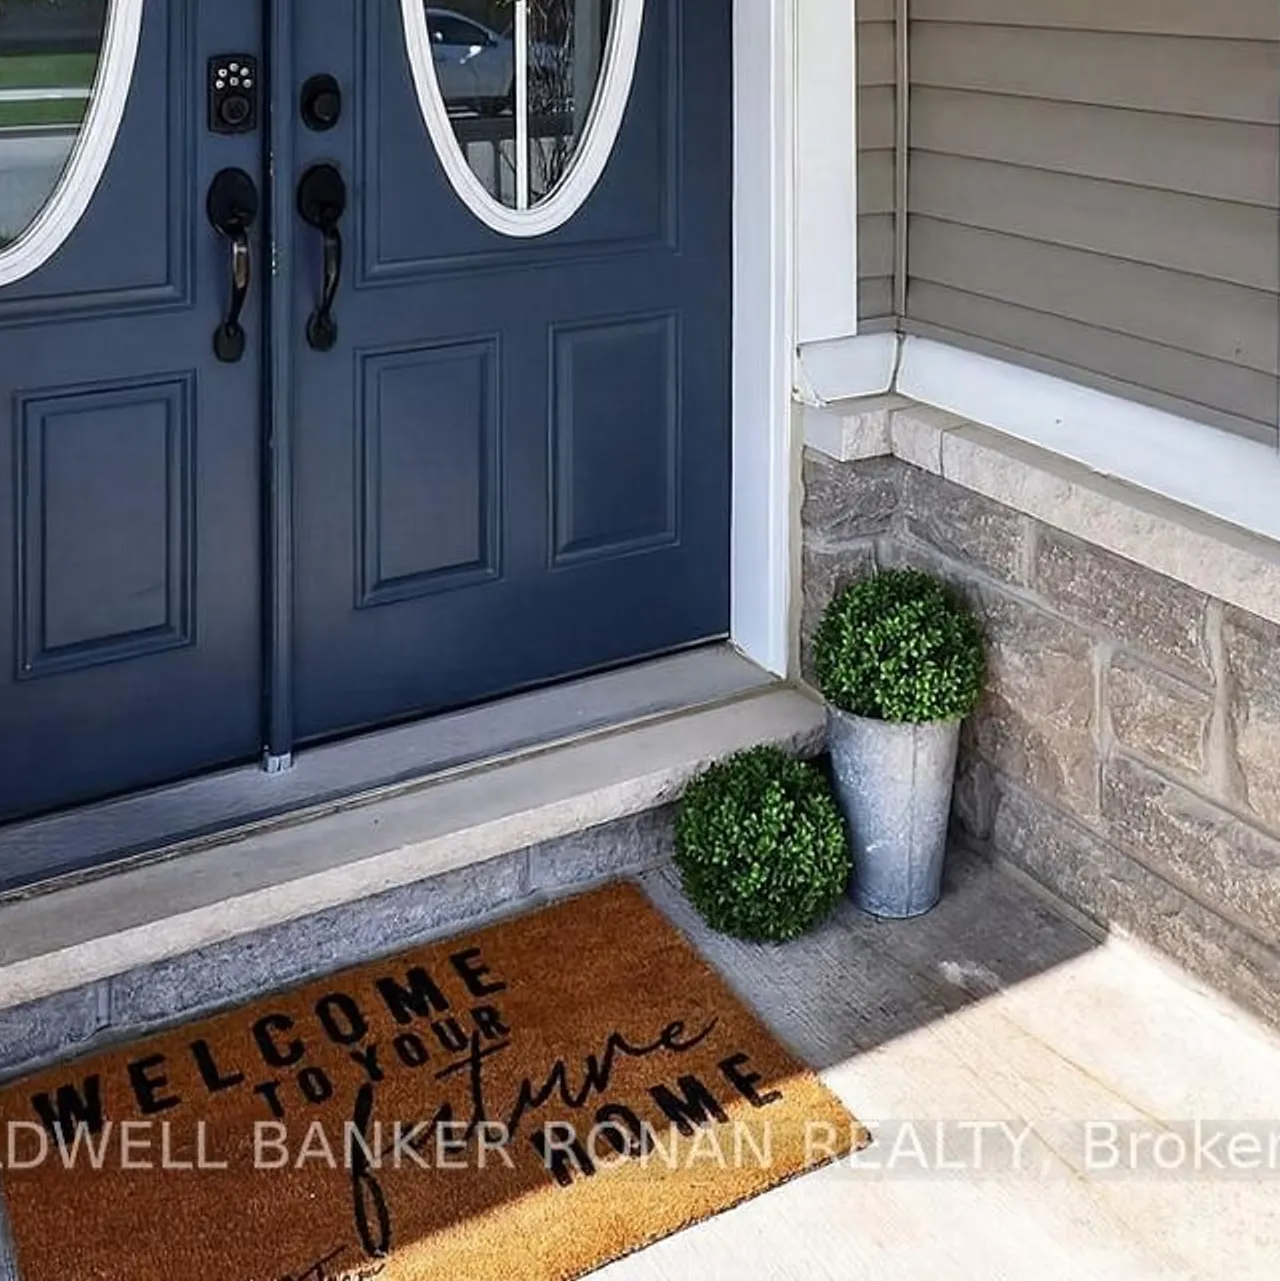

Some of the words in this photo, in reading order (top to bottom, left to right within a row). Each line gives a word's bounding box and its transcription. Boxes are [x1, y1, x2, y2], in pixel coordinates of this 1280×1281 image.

[32, 947, 507, 1145] WELCOME
[253, 1066, 333, 1119] TO
[350, 1004, 511, 1083] YOUR
[532, 1052, 783, 1187] HOME
[350, 1015, 720, 1258] future
